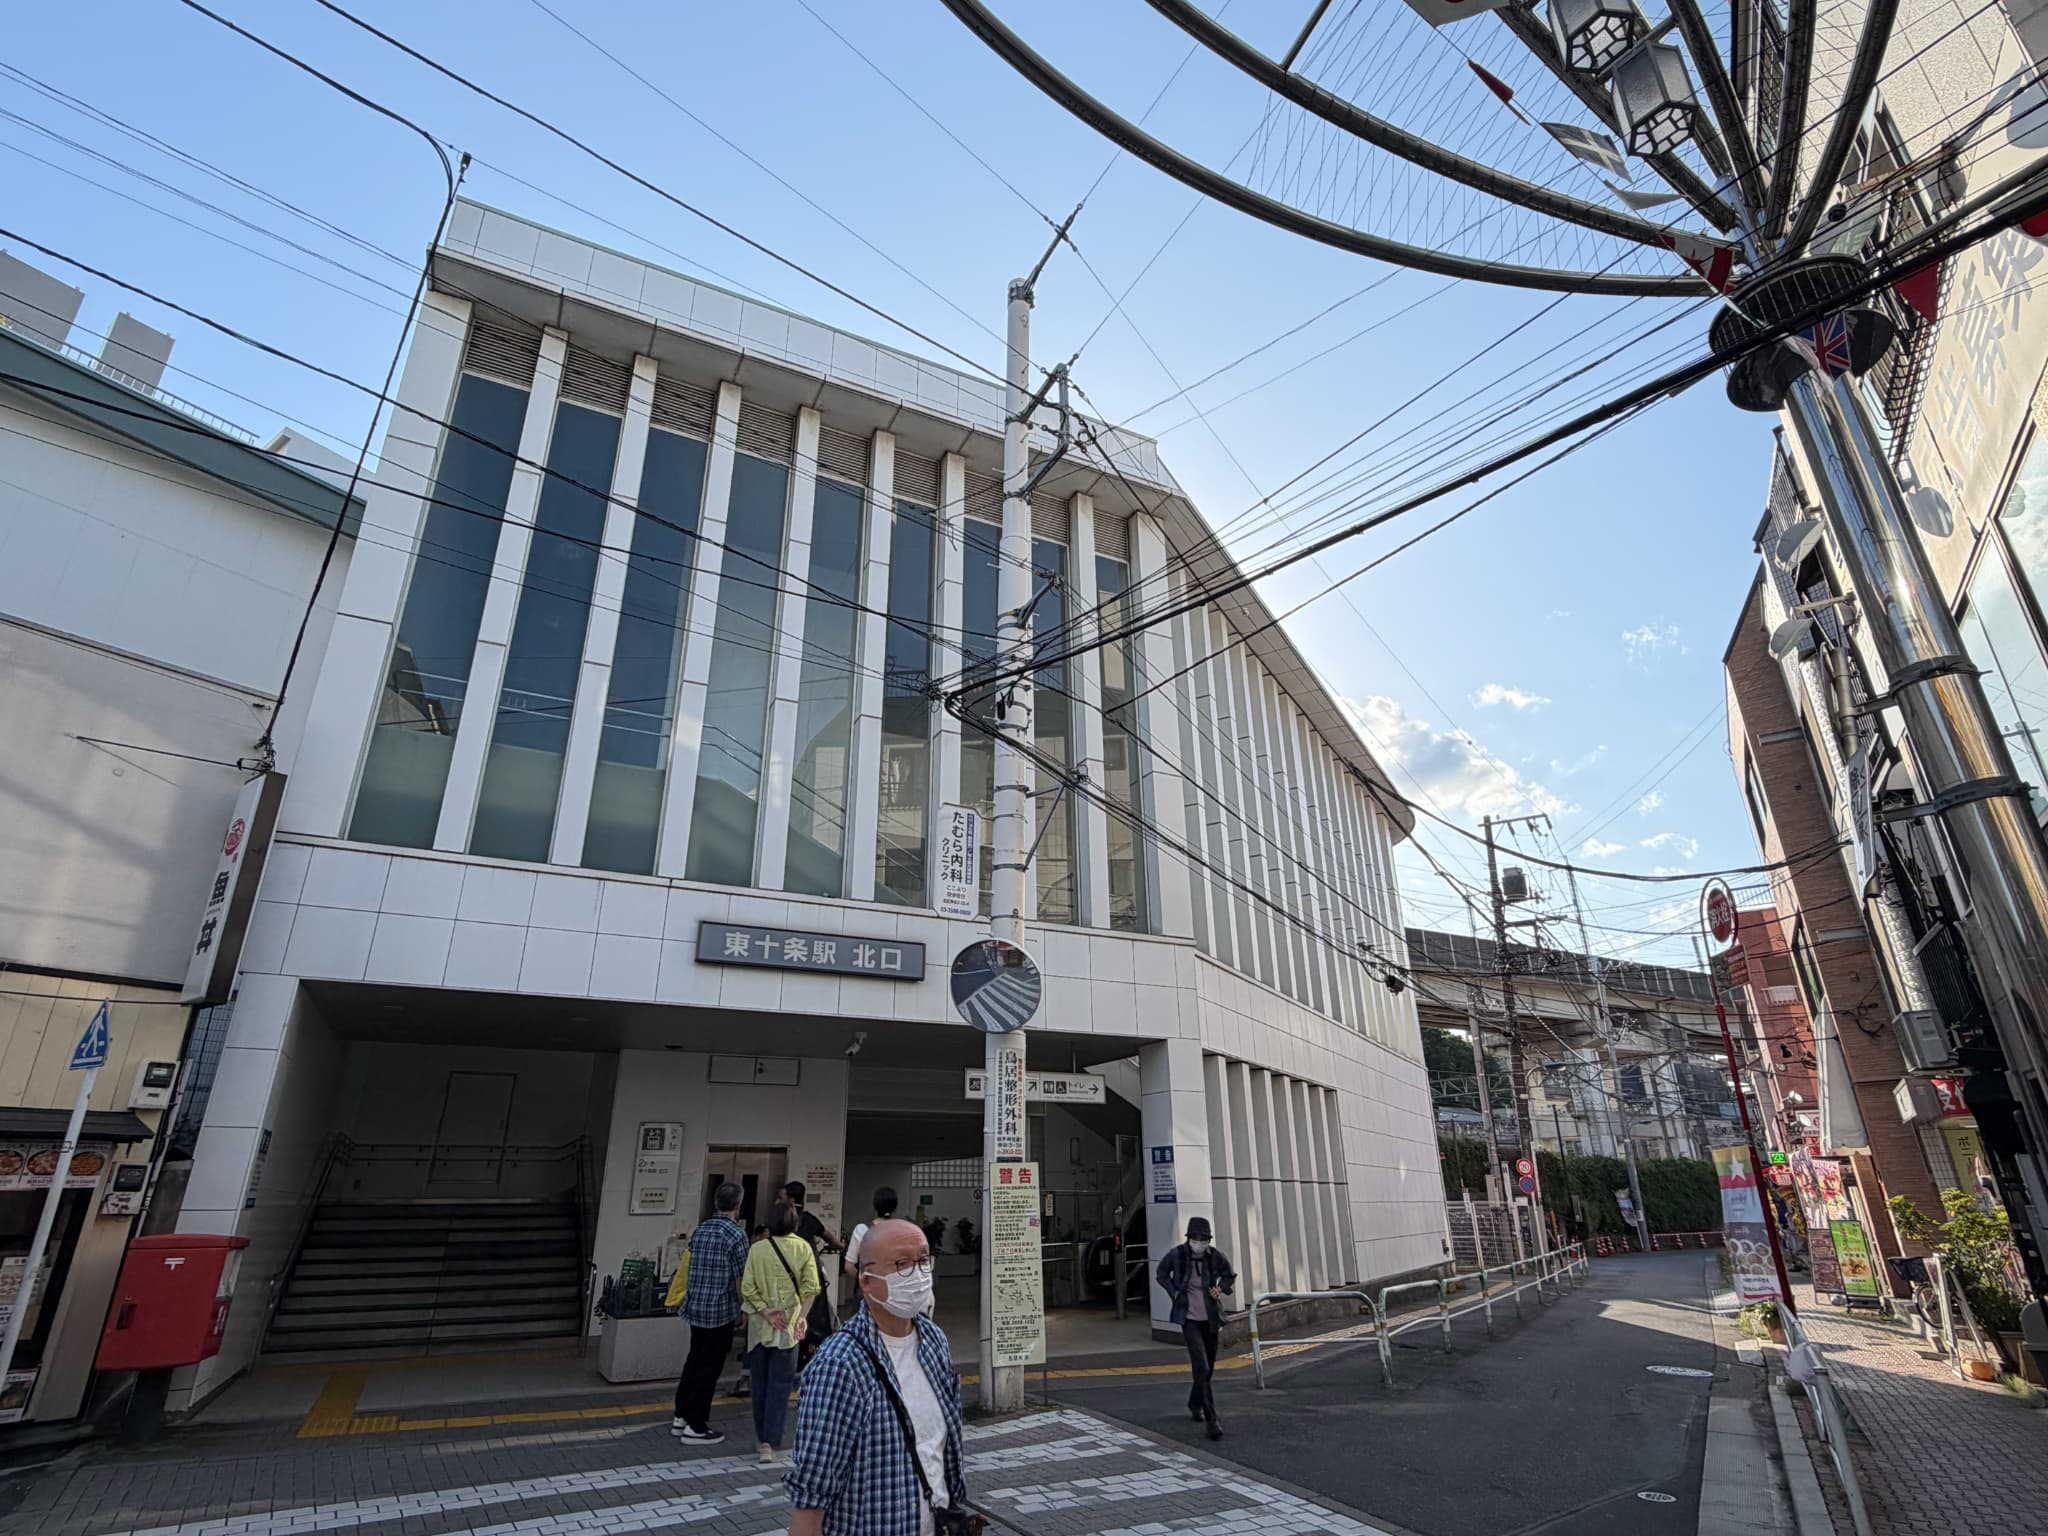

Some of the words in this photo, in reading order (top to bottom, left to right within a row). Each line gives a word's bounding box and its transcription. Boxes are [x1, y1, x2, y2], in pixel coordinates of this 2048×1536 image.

[940, 838, 950, 881] クリニック
[950, 811, 965, 884] たむら内科
[723, 931, 836, 965] 東十条駅
[852, 943, 902, 971] 北口
[999, 1167, 1032, 1185] 警告
